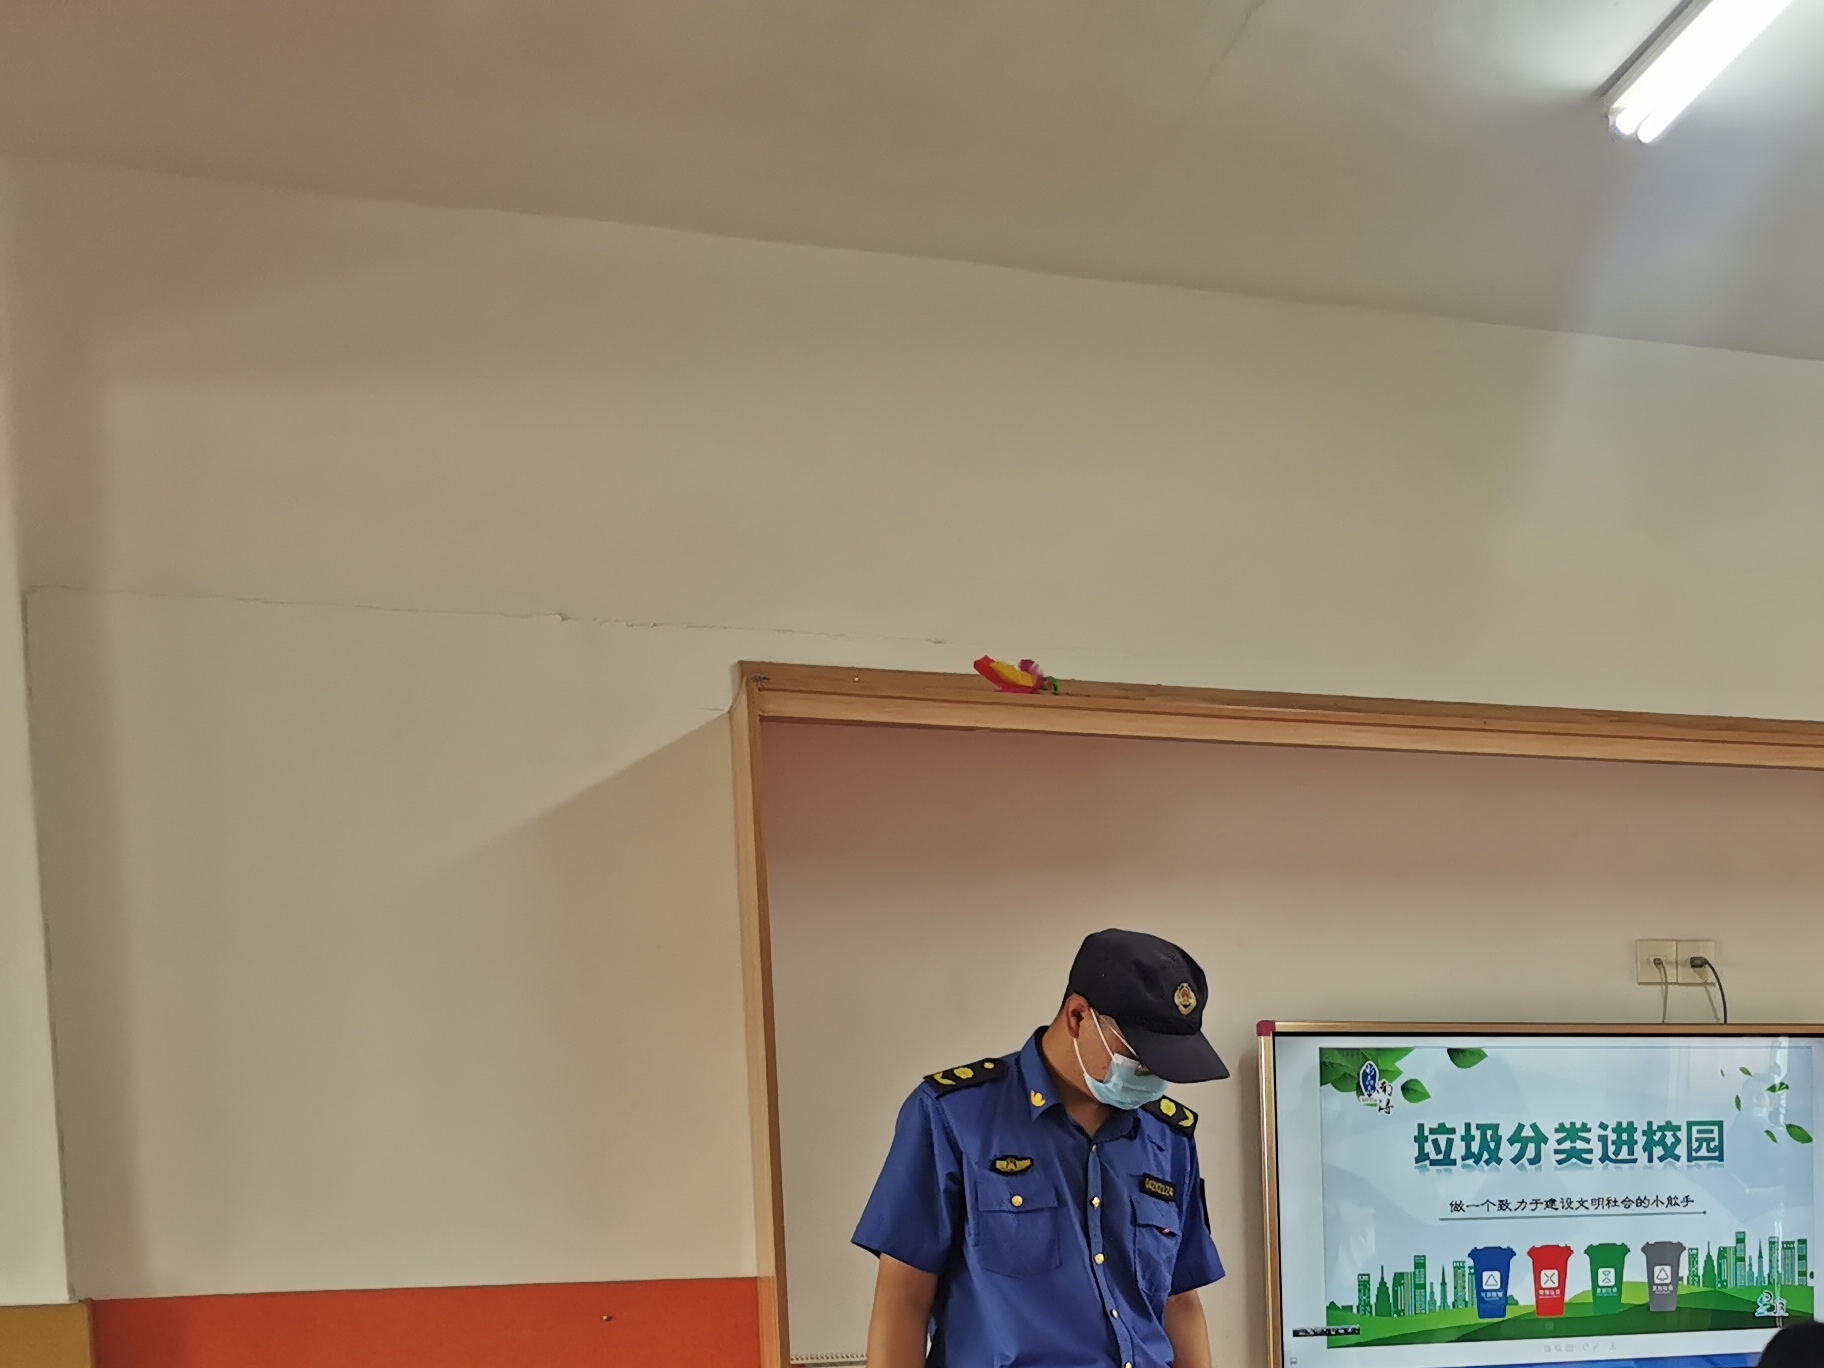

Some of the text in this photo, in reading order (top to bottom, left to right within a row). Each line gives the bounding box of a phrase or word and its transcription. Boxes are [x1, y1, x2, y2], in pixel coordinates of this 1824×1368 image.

[1413, 1120, 1725, 1166] 垃圾分类进校园
